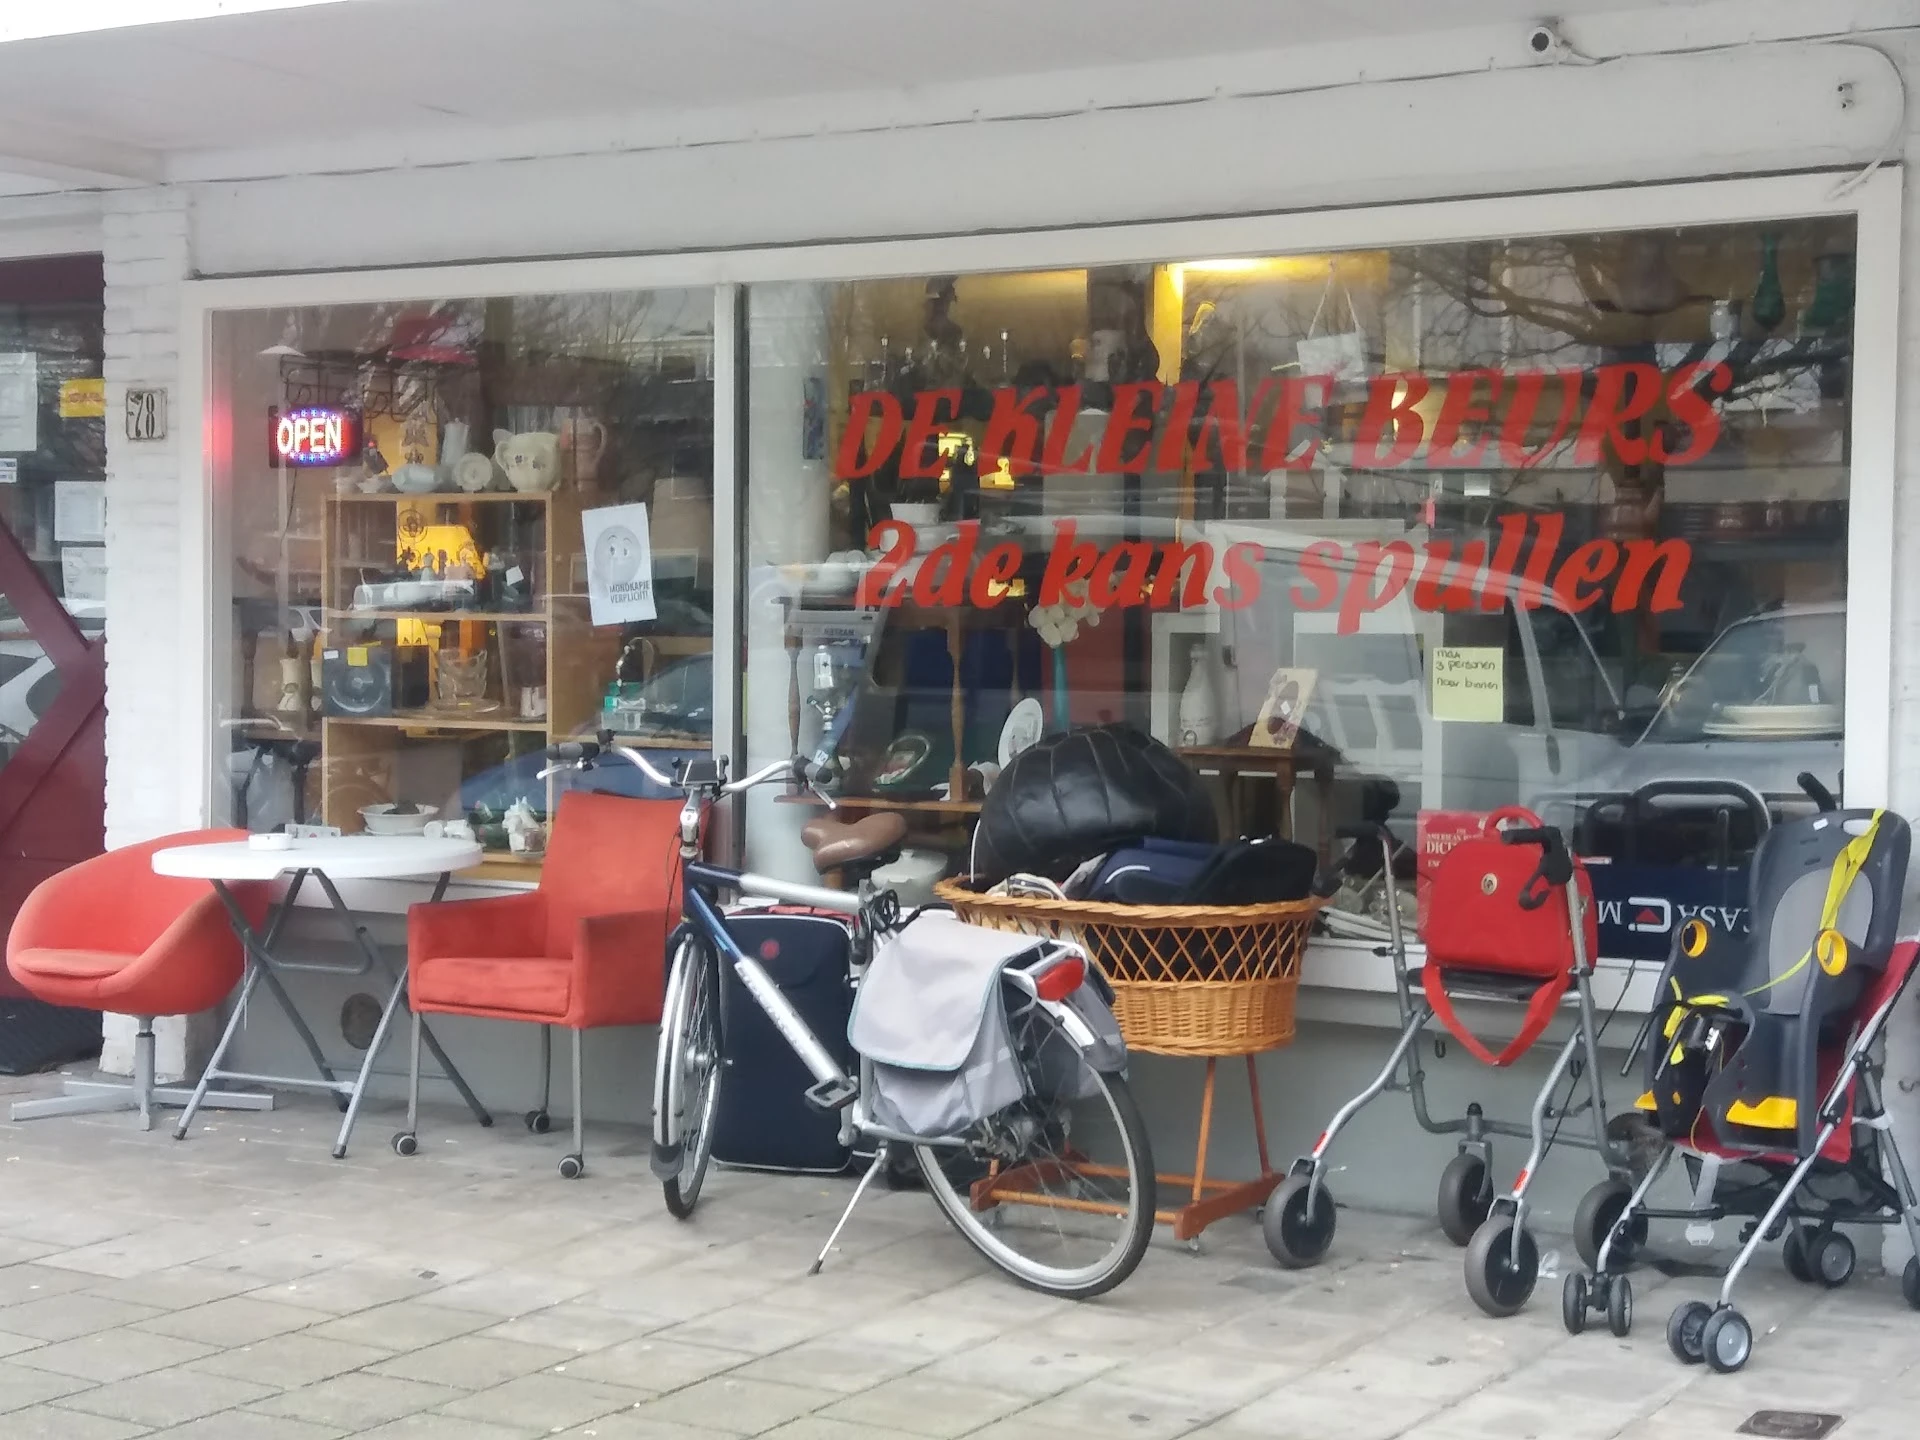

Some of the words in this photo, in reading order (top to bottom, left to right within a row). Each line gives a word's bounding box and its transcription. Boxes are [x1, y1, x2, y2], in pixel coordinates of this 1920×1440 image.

[277, 417, 342, 454] OPEN
[834, 387, 963, 480] DE
[978, 374, 1334, 476] KLEINE
[1351, 360, 1733, 471] BEURS
[855, 519, 1022, 609] 2de
[1039, 518, 1266, 609] kans
[1289, 512, 1691, 636] spullen
[1436, 661, 1445, 671] 3
[1448, 660, 1496, 671] personen
